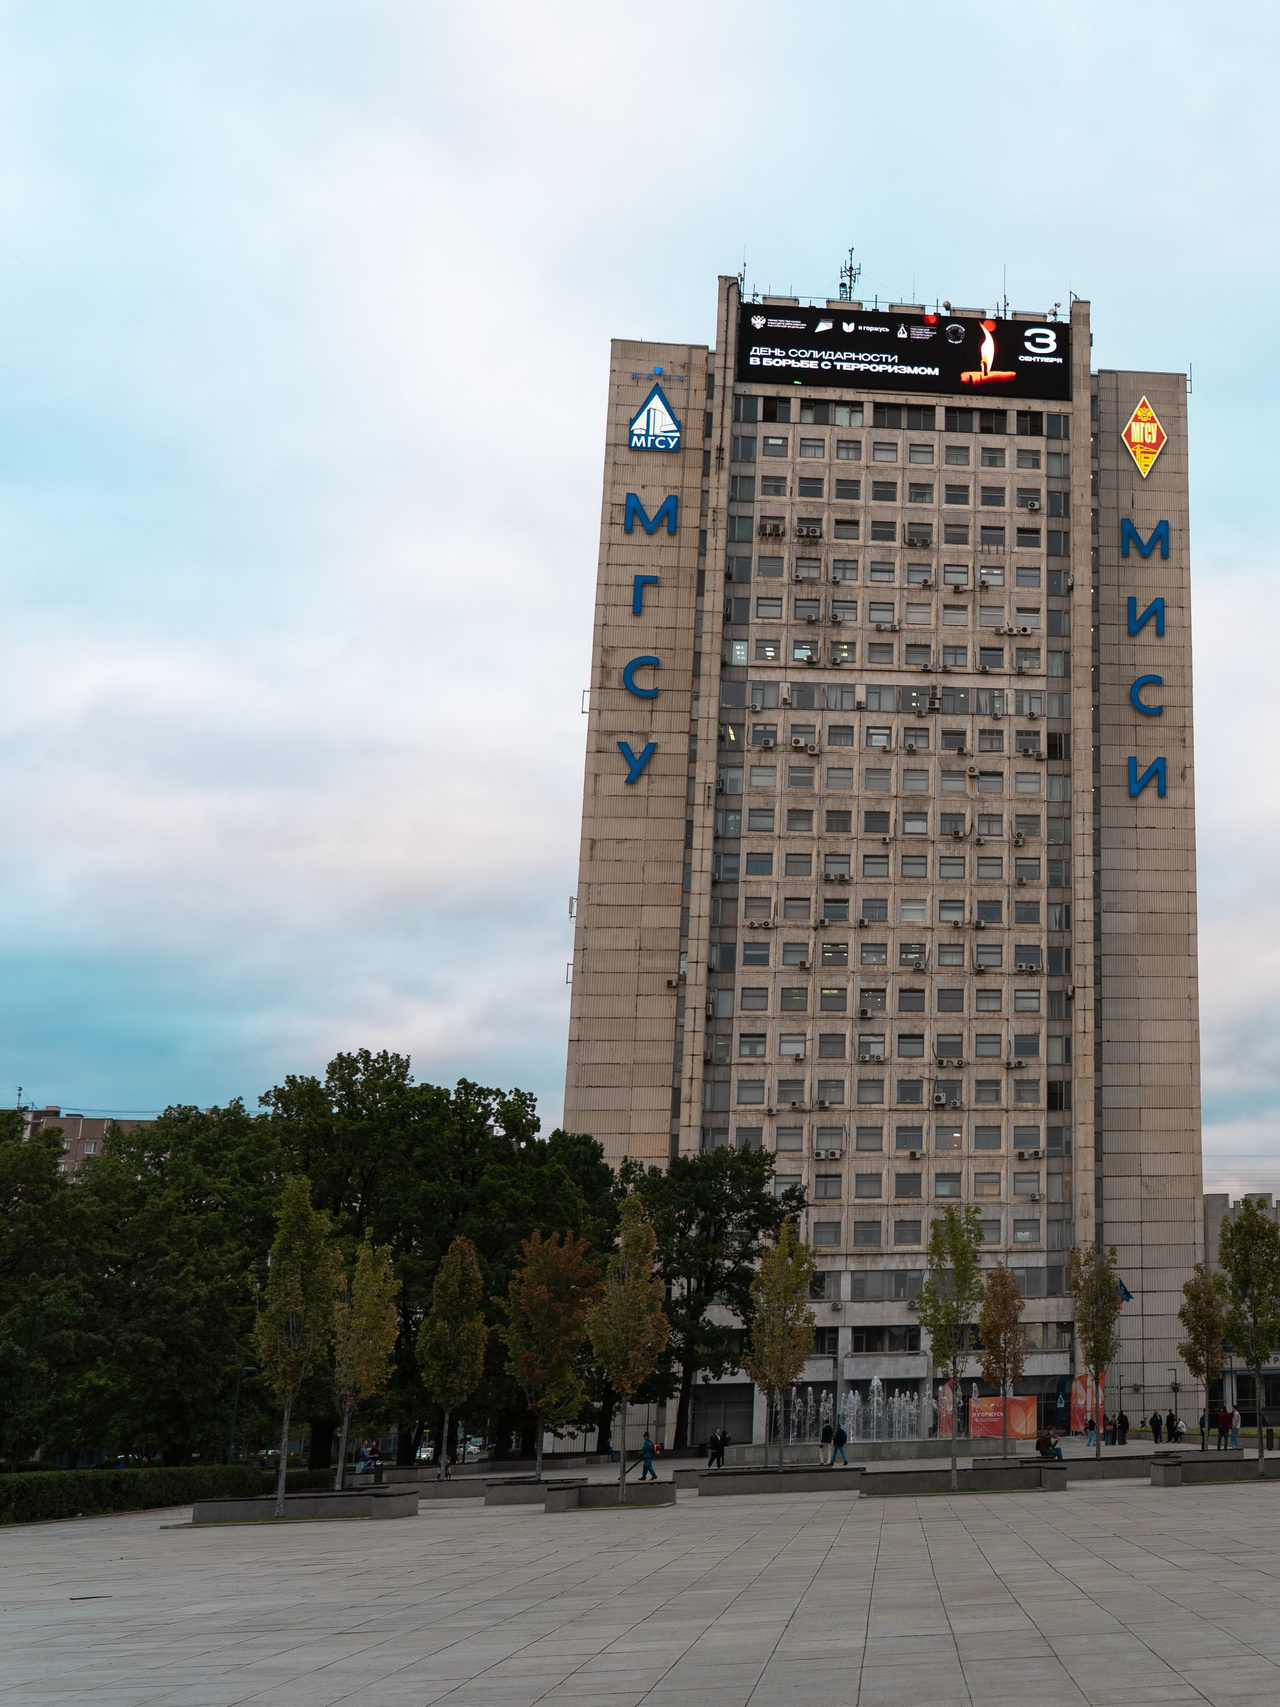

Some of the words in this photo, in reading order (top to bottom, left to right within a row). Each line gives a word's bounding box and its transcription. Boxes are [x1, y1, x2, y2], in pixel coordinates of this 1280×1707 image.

[863, 325, 890, 333] горжусь
[1024, 327, 1057, 354] 3
[750, 346, 786, 357] ДЕНЬ
[788, 348, 899, 363] СОЛИДАРНОСТИ
[1018, 355, 1063, 364] СЕНТЯБРЯ
[749, 356, 761, 366] В
[762, 357, 819, 369] БОРЬБЕ
[820, 360, 832, 370] С
[833, 361, 940, 376] ТЕРРОРИЗМОМ
[631, 435, 679, 449] МГСУ
[1131, 421, 1158, 444] МГСУ
[617, 493, 678, 784] МГСУ
[1121, 518, 1170, 798] МИСИ
